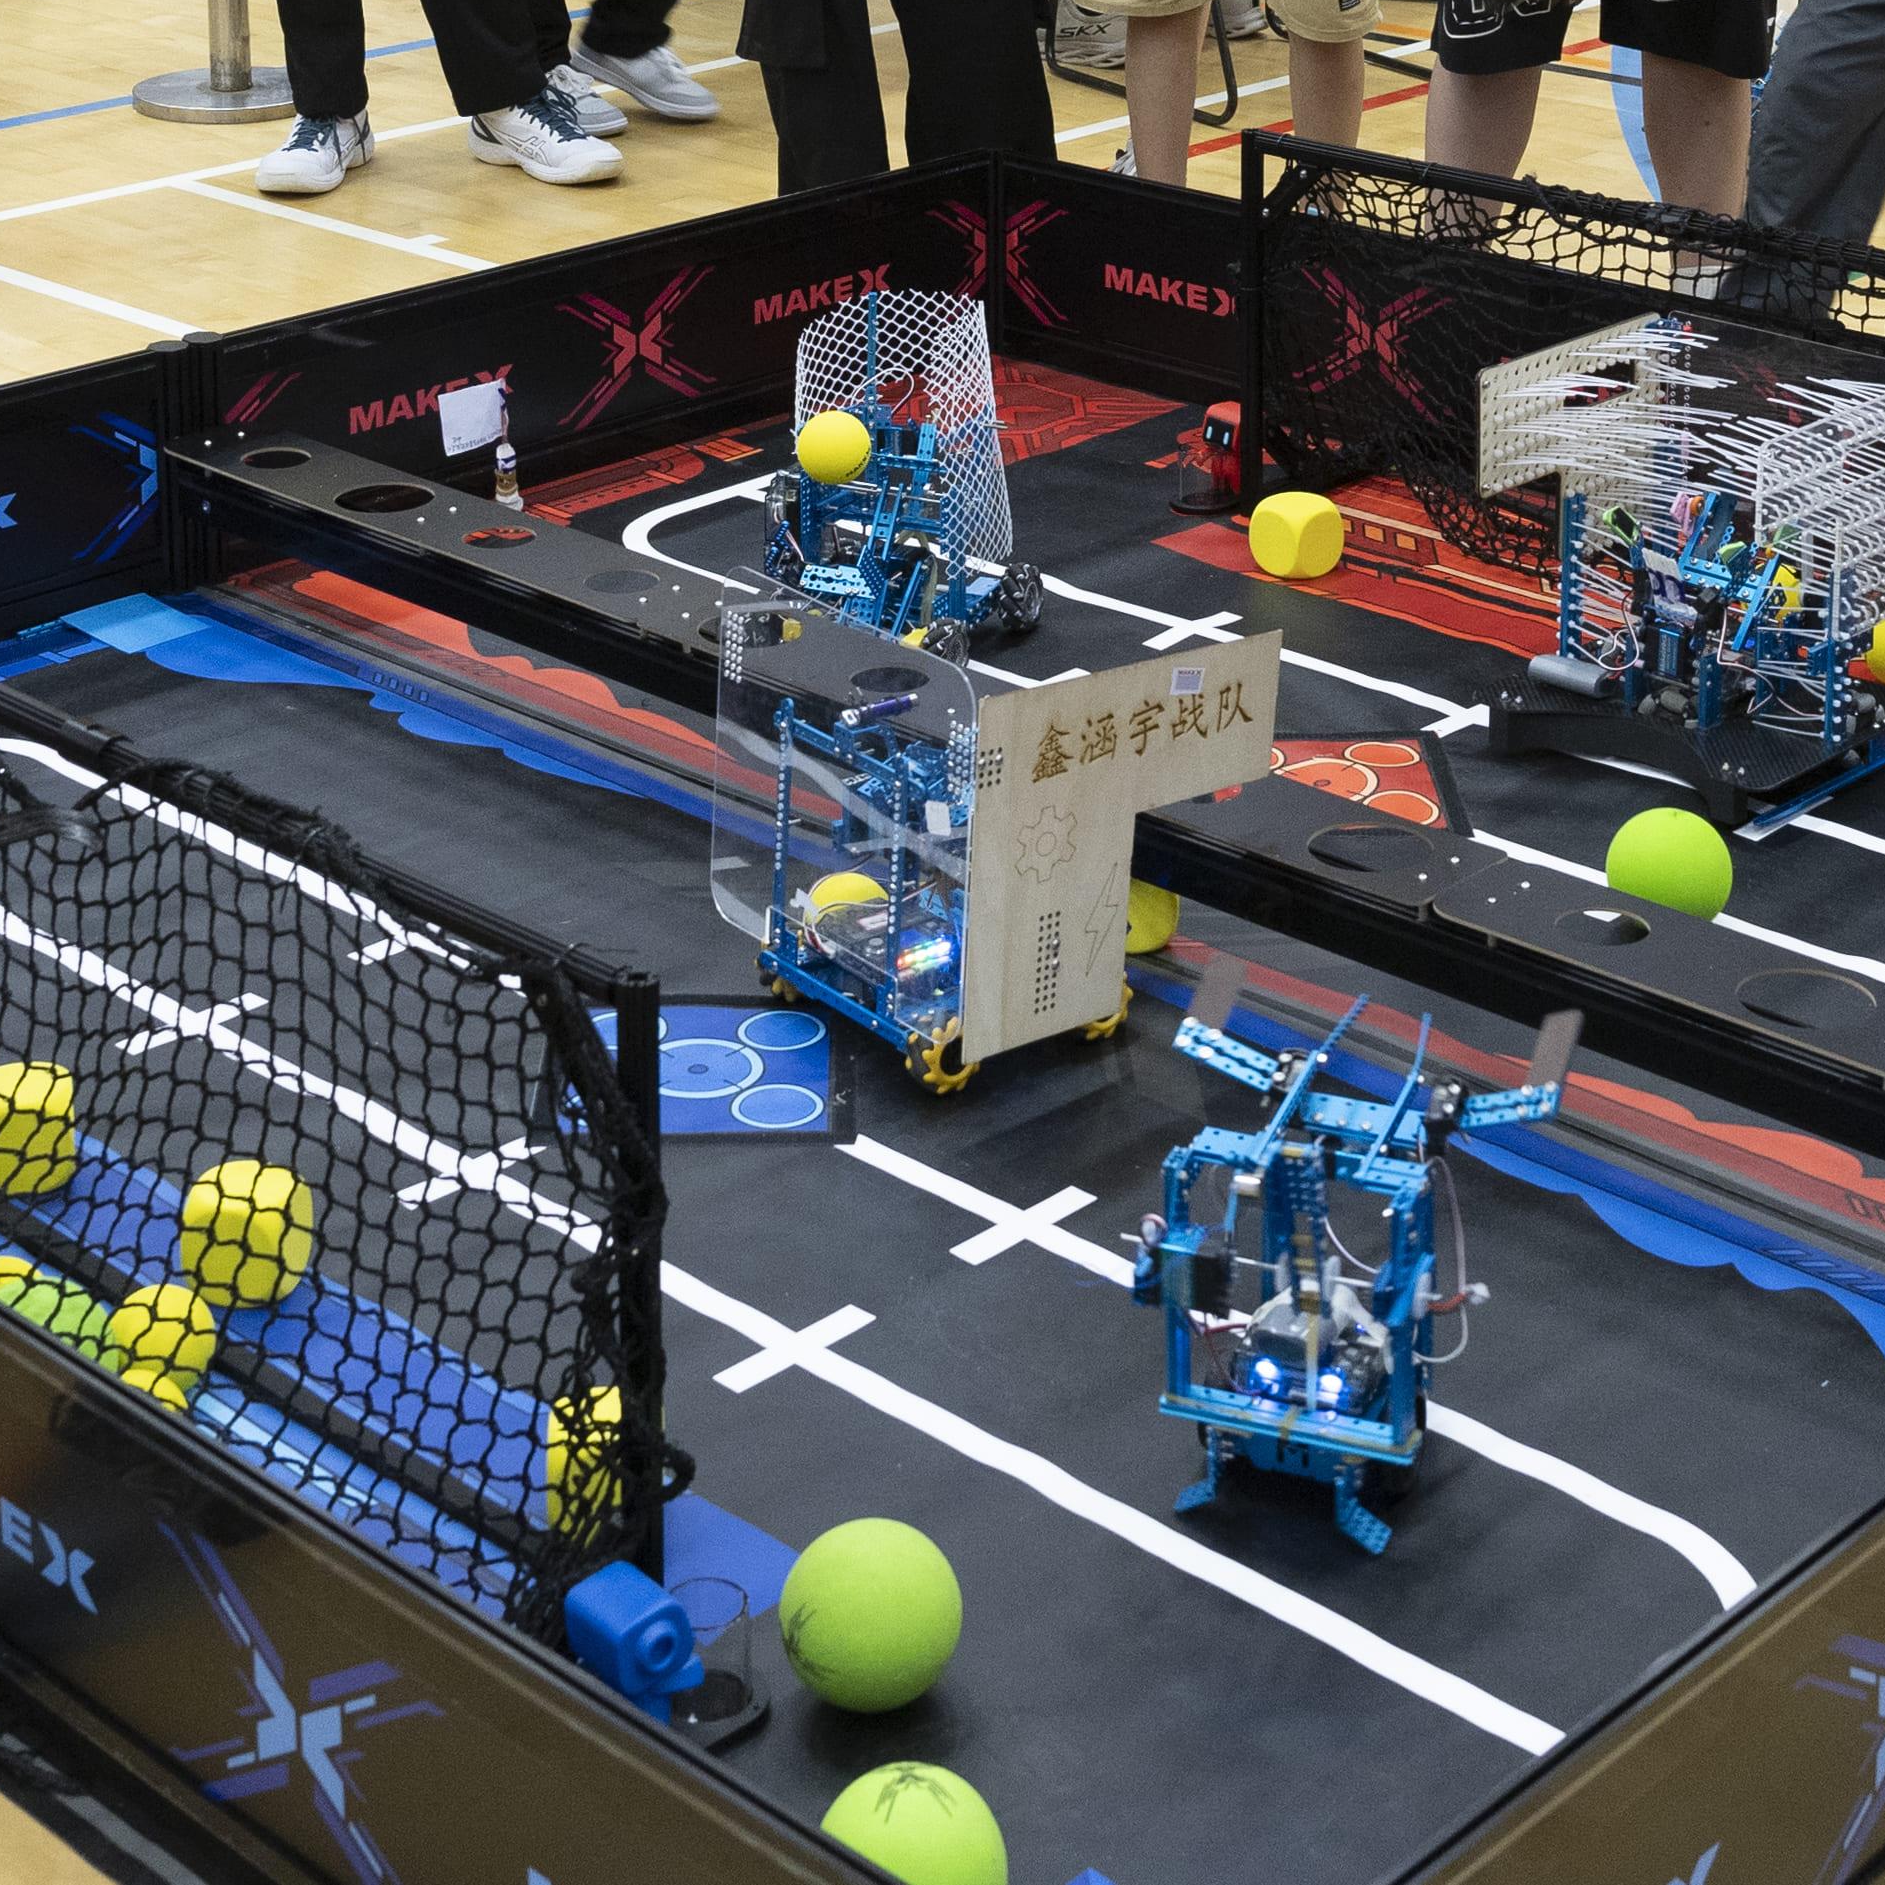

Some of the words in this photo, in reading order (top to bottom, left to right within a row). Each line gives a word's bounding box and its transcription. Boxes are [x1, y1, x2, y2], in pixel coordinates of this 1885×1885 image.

[1031, 681, 1254, 784] 鑫涵宇战队
